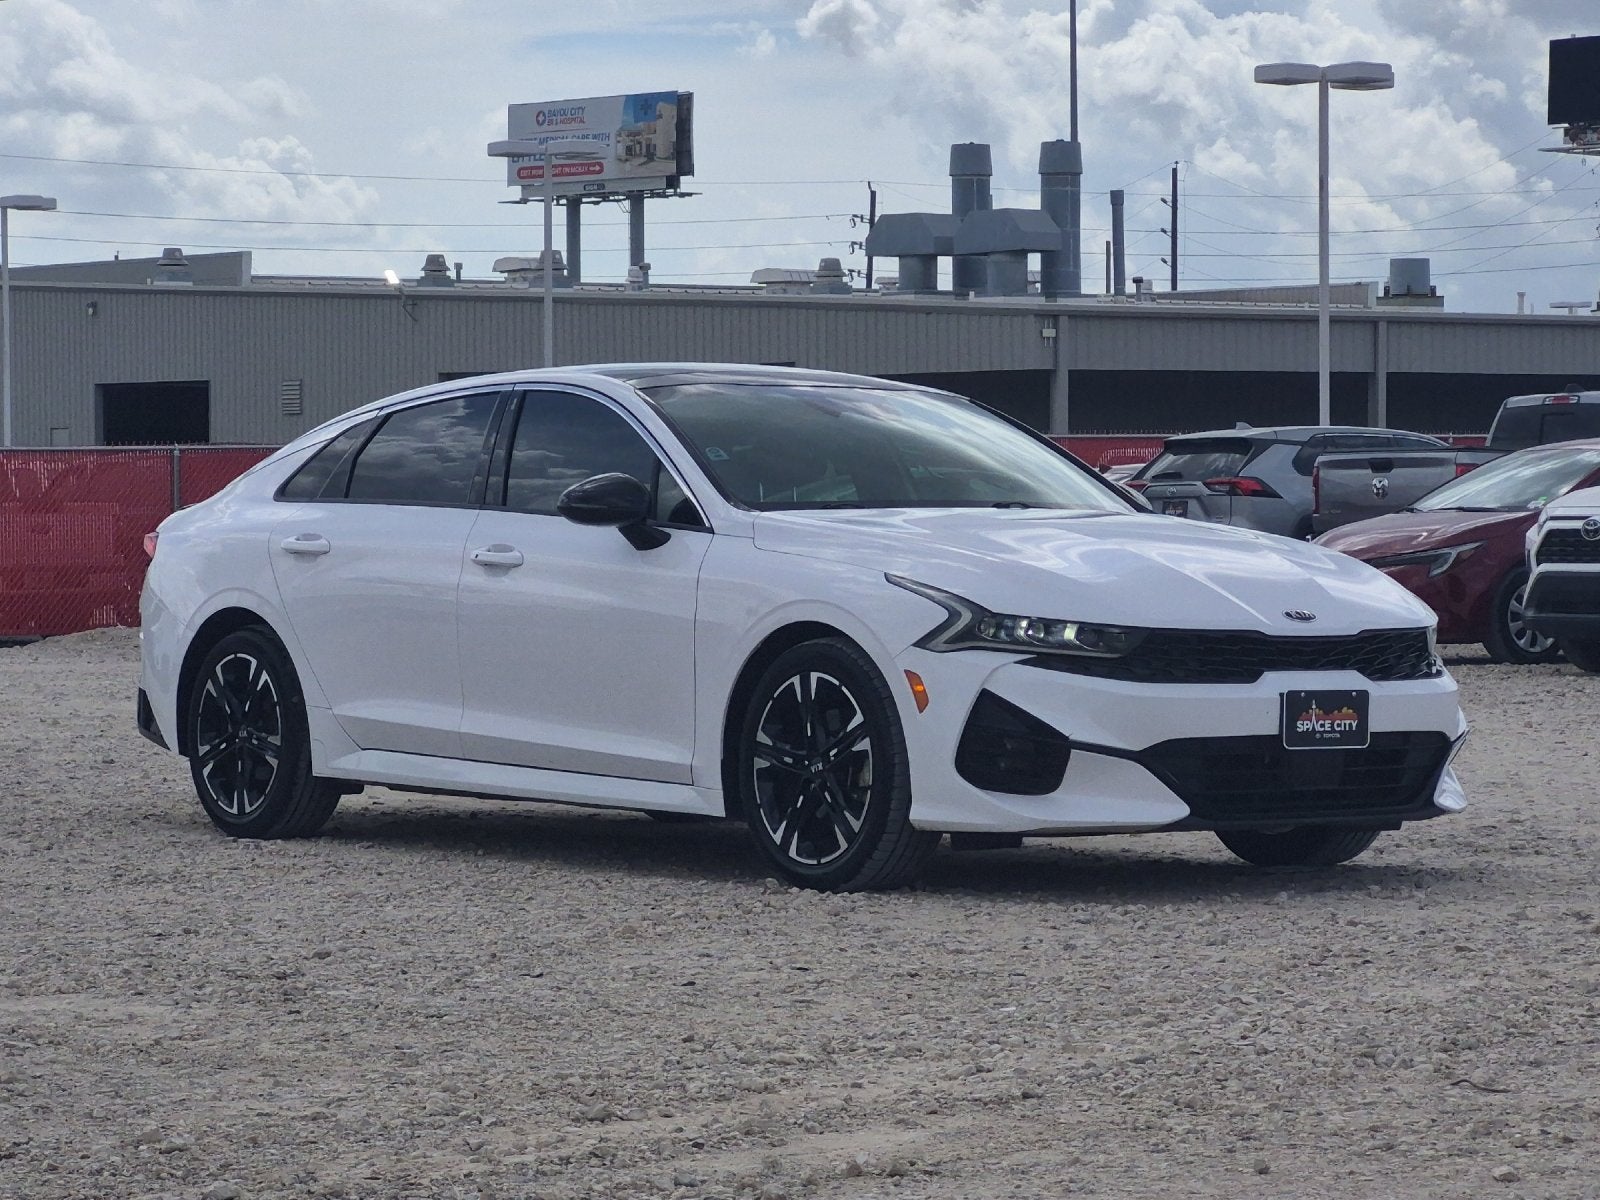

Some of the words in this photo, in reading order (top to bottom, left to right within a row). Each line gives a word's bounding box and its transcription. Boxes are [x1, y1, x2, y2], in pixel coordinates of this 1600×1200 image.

[547, 107, 569, 118] BAYOU
[570, 106, 586, 116] CITY
[559, 116, 586, 125] HOSPITAL
[592, 132, 610, 142] WITH
[1296, 719, 1332, 732] SPACE
[1333, 719, 1358, 731] CITY
